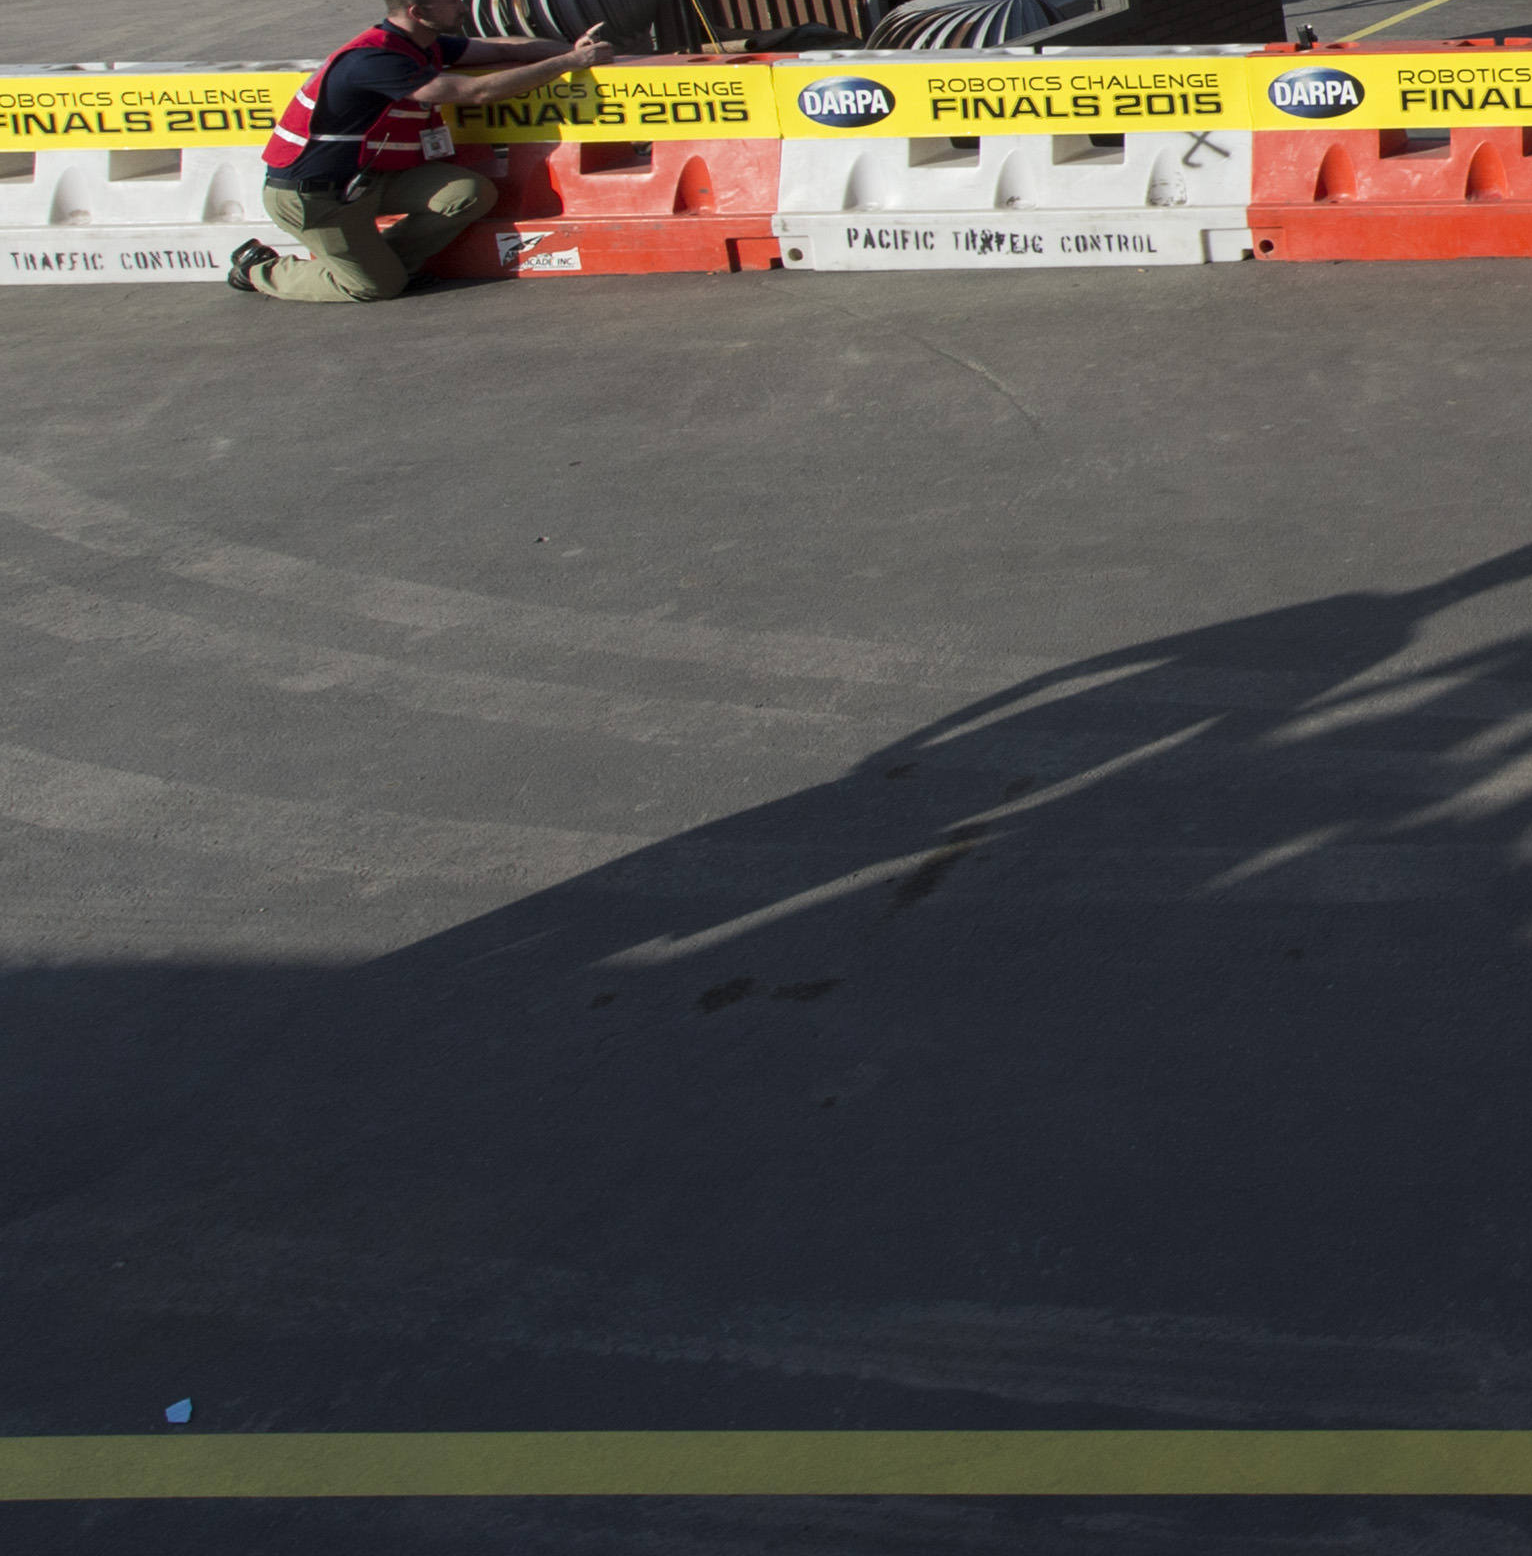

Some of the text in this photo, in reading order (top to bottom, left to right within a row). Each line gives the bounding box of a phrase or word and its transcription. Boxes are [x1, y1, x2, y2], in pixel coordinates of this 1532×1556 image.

[928, 74, 1219, 93] ROBOTICS CHALLENGE
[1398, 68, 1532, 84] ROBOTICS
[121, 89, 272, 106] CHALLENGE
[595, 81, 744, 98] CHALLENGE
[1273, 80, 1359, 106] DARPA
[455, 101, 749, 127] FINALS 2015
[802, 89, 890, 115] DARPA
[931, 93, 1222, 121] FINALS 2015
[166, 108, 277, 132] 2015
[846, 228, 935, 250] PACIFIC
[1061, 234, 1157, 253] CONTROL
[10, 250, 220, 271] TRAFFIC CONTROL
